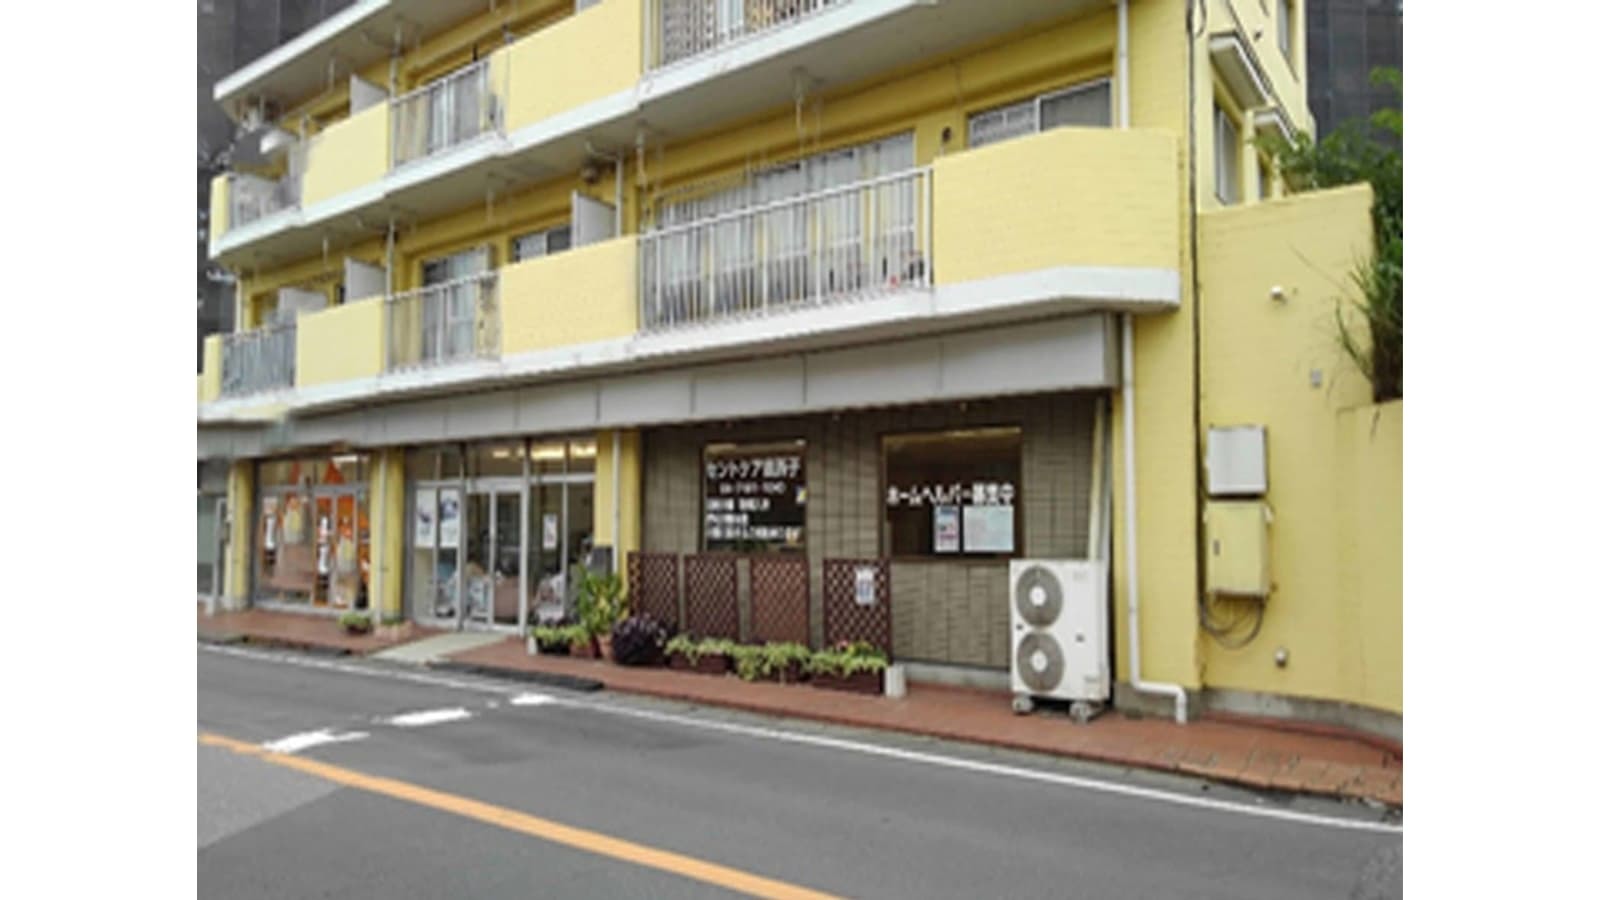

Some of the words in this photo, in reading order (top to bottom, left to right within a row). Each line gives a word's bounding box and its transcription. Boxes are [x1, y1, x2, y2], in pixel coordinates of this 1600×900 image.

[706, 457, 800, 478] セントケア子
[888, 482, 1014, 505] ホームヘルパー中
